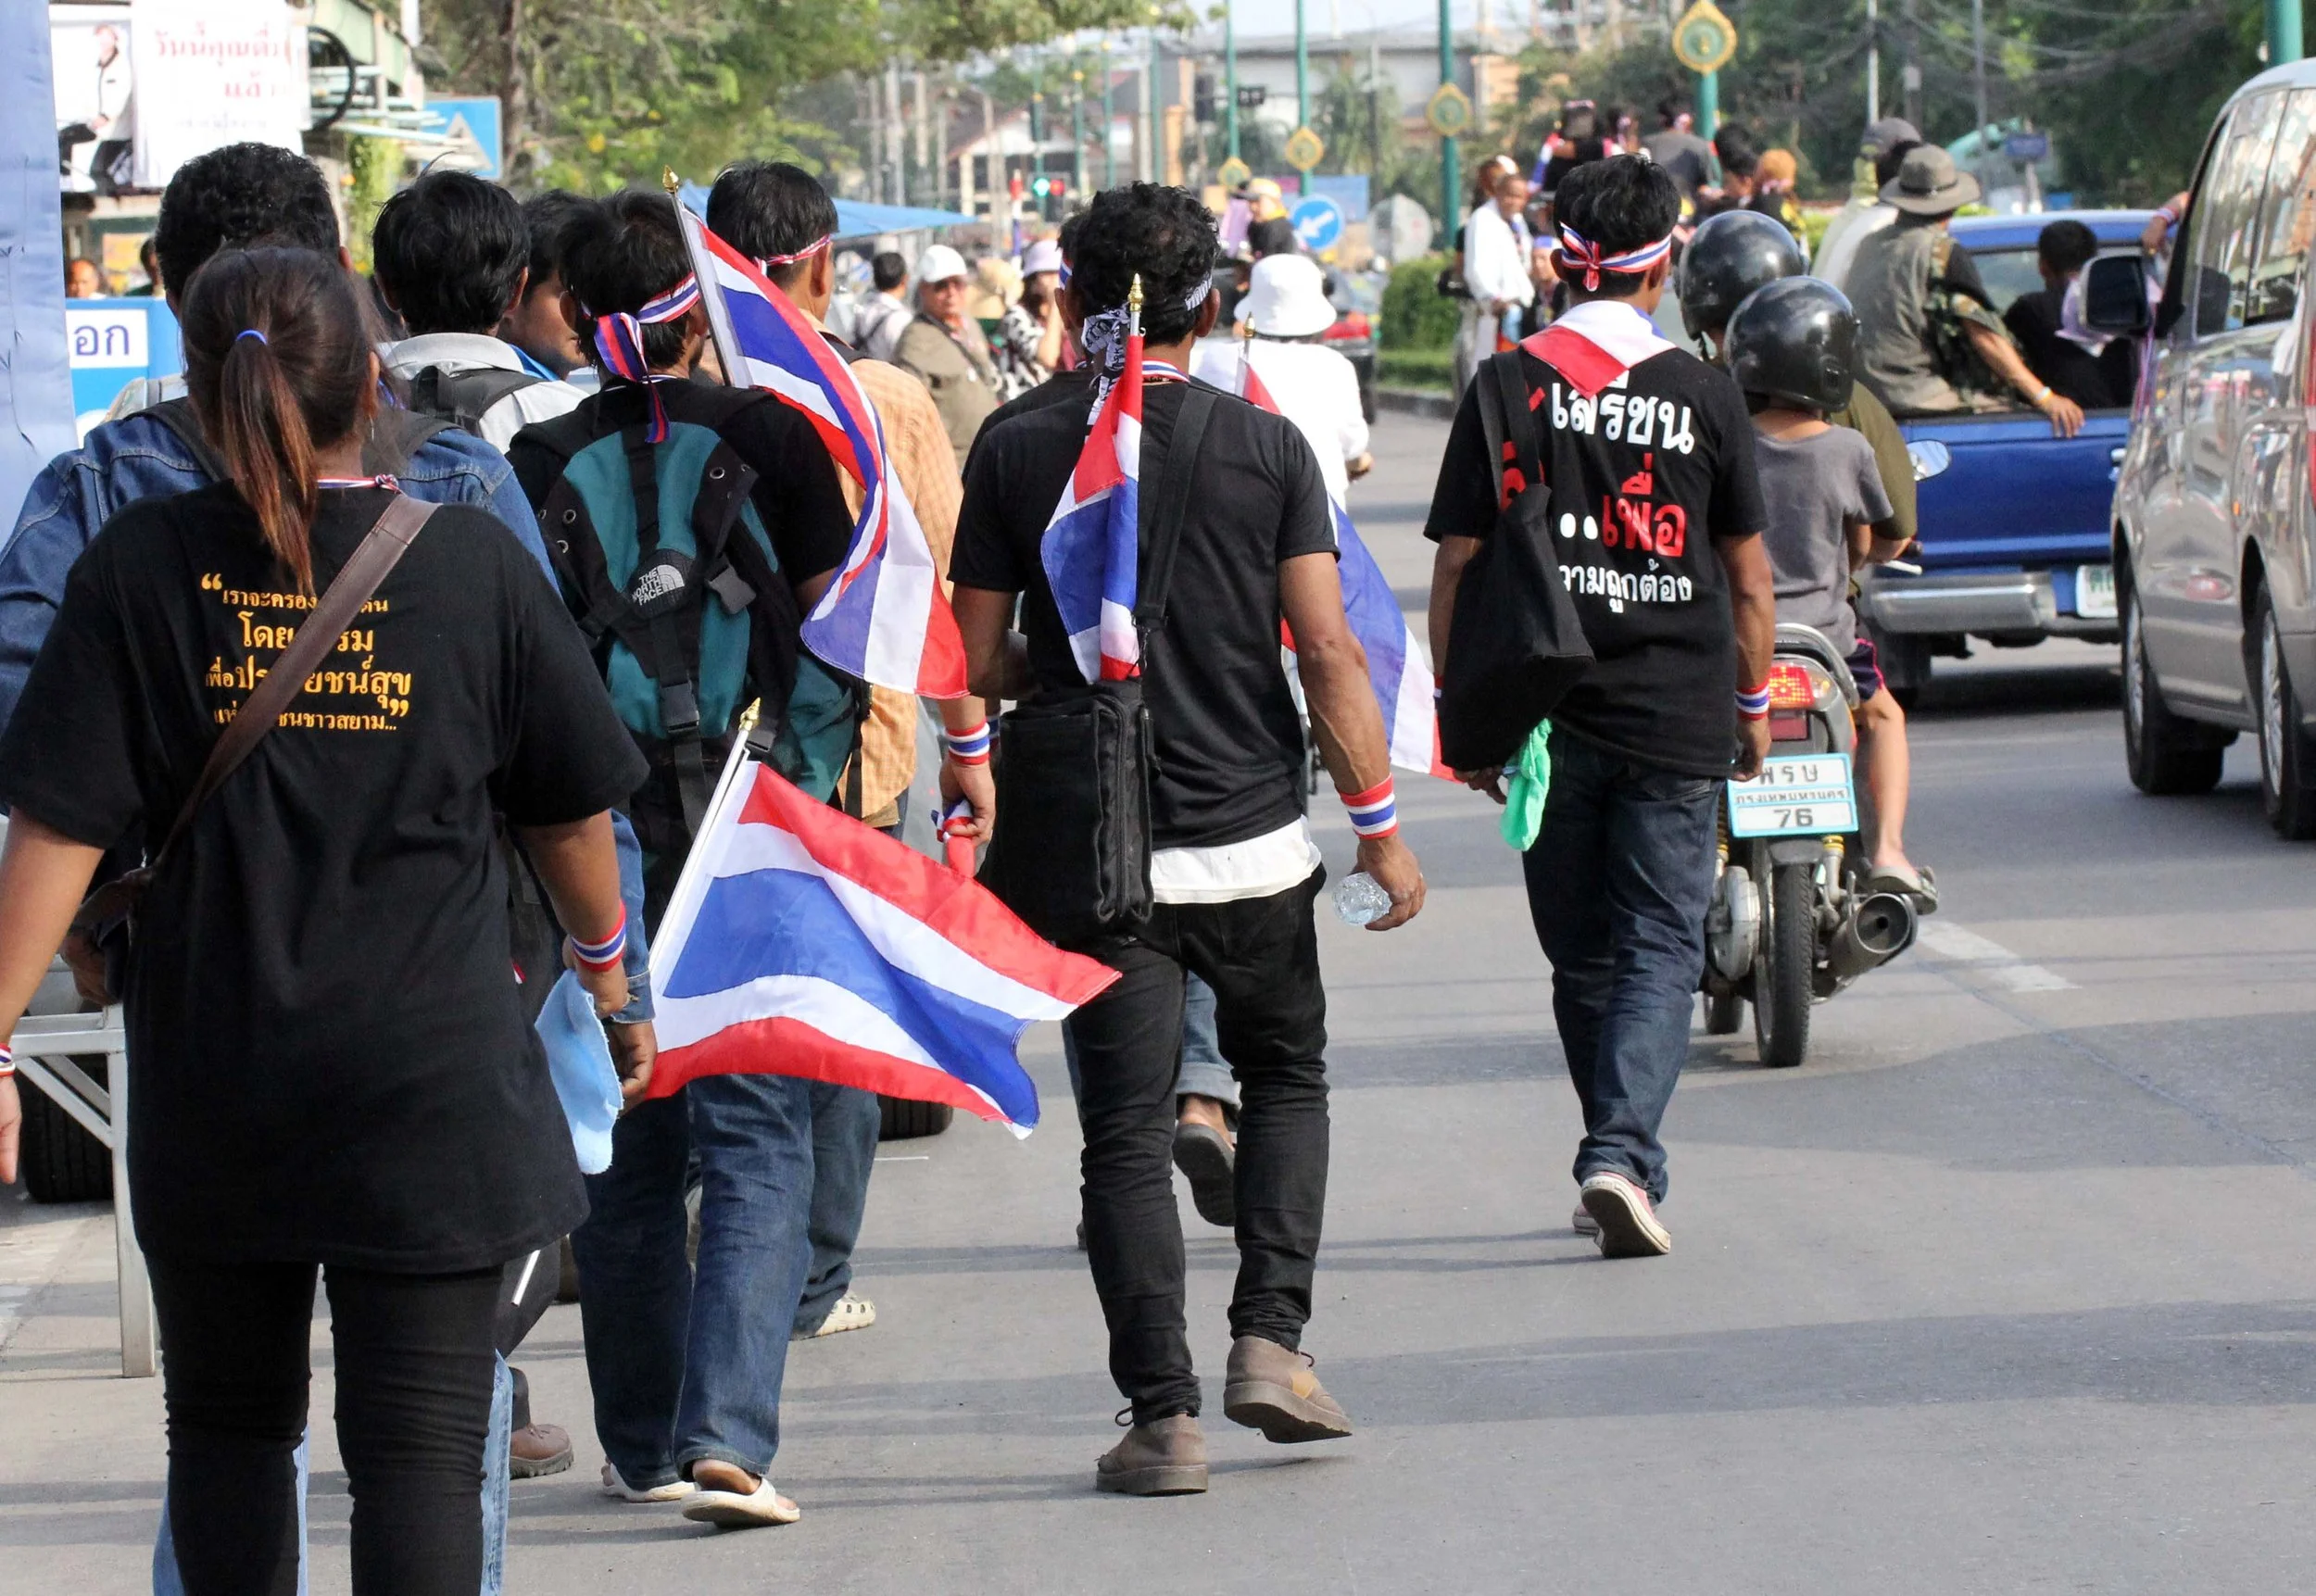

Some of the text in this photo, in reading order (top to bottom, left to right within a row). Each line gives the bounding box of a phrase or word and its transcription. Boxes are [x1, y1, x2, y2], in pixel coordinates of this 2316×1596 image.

[73, 324, 130, 356] อก
[639, 567, 658, 584] THE
[1558, 558, 1693, 613] วามถูกต้อง
[631, 576, 661, 603] NORTH
[638, 584, 663, 606] FACE
[1773, 808, 1814, 828] 76
